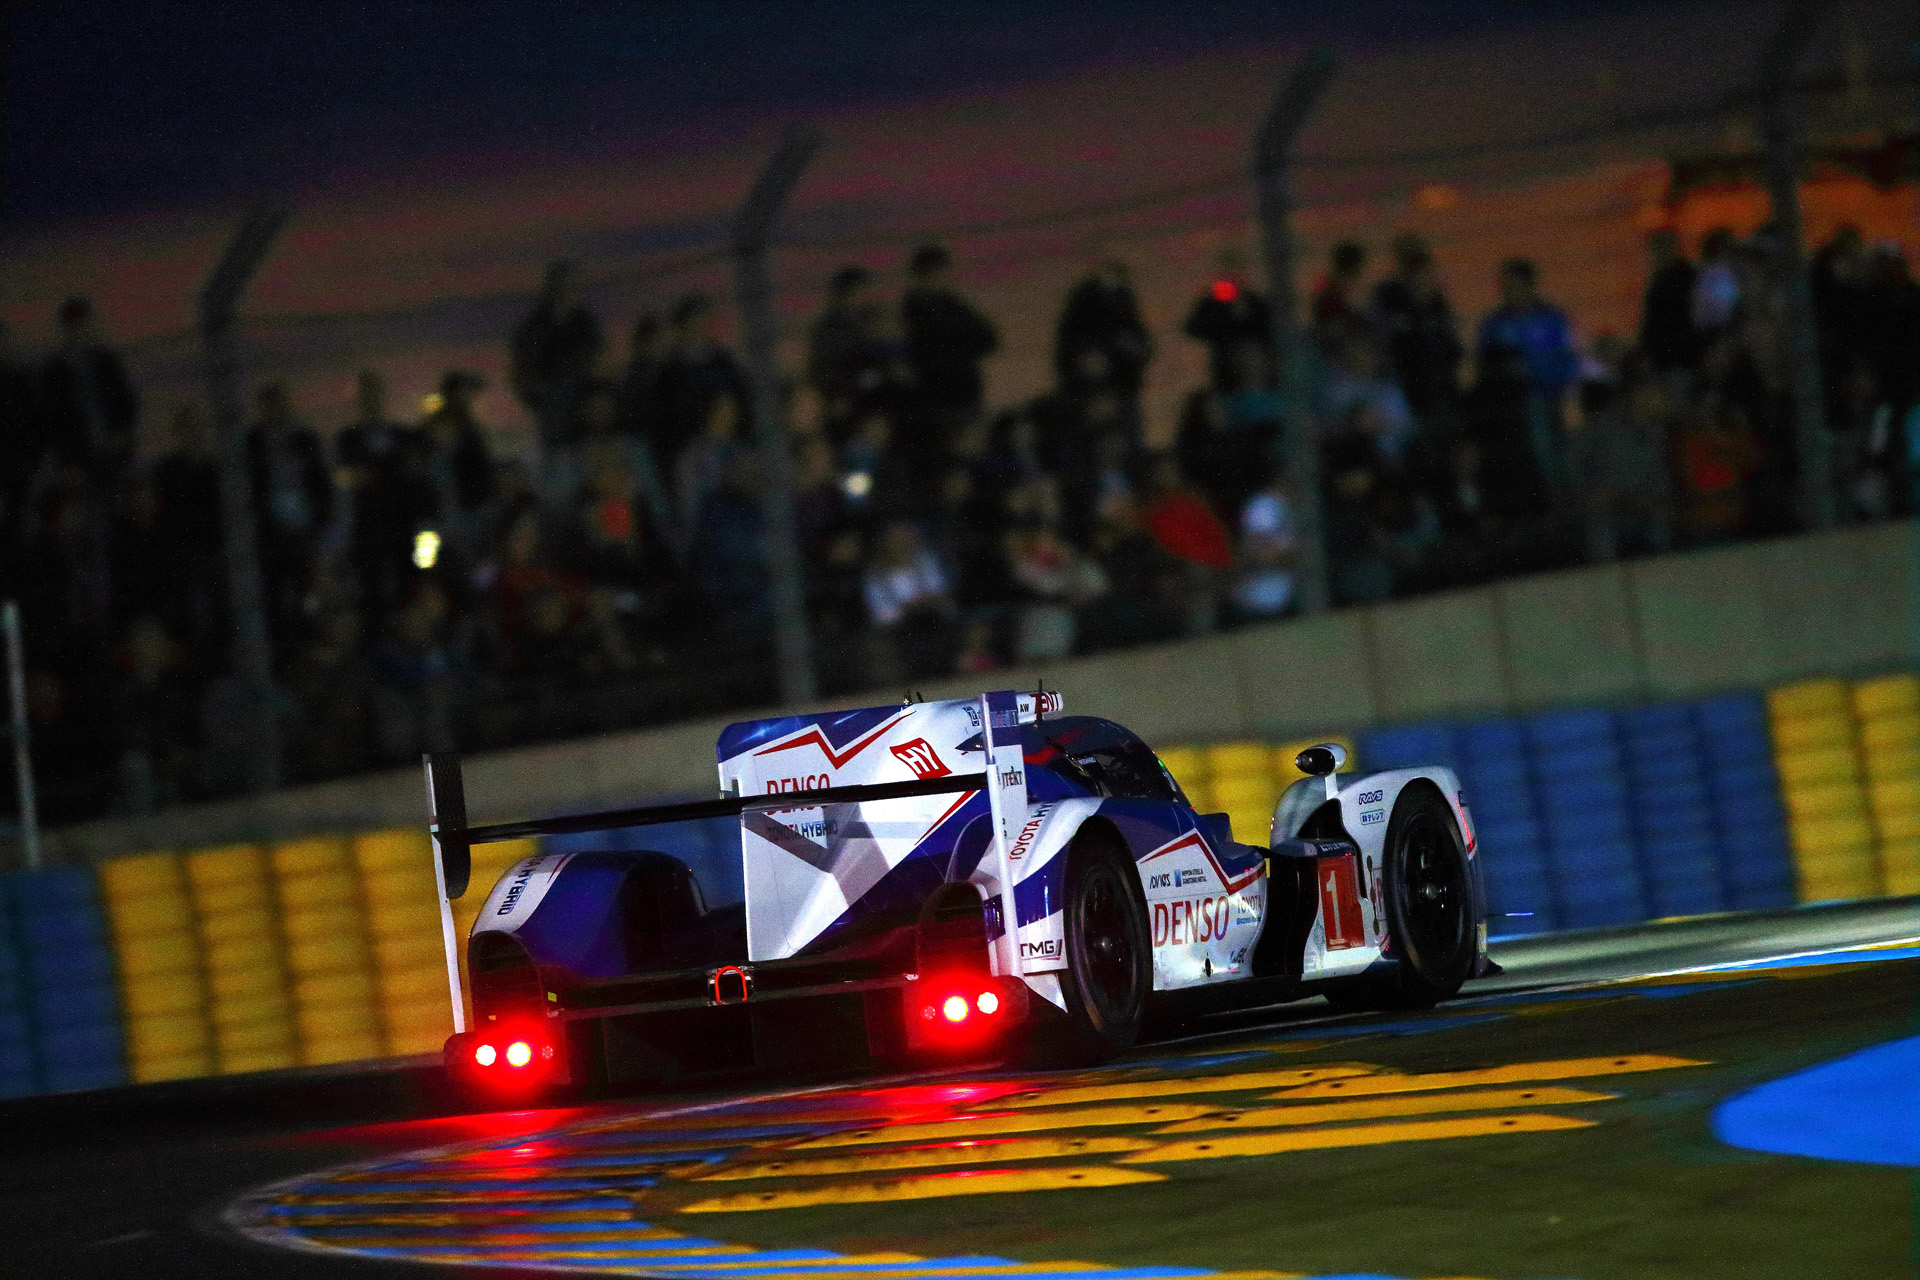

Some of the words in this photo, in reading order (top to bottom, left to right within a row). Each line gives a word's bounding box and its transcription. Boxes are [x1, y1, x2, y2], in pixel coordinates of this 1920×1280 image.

[1020, 704, 1030, 713] AW
[896, 743, 940, 775] HY
[766, 773, 831, 816] DENSO
[1359, 790, 1383, 805] RAYS
[801, 819, 839, 838] HYBRID
[1009, 819, 1043, 861] TOYOTA
[497, 868, 536, 915] HYBRID
[1326, 870, 1347, 946] 1
[1154, 896, 1230, 948] DENSO
